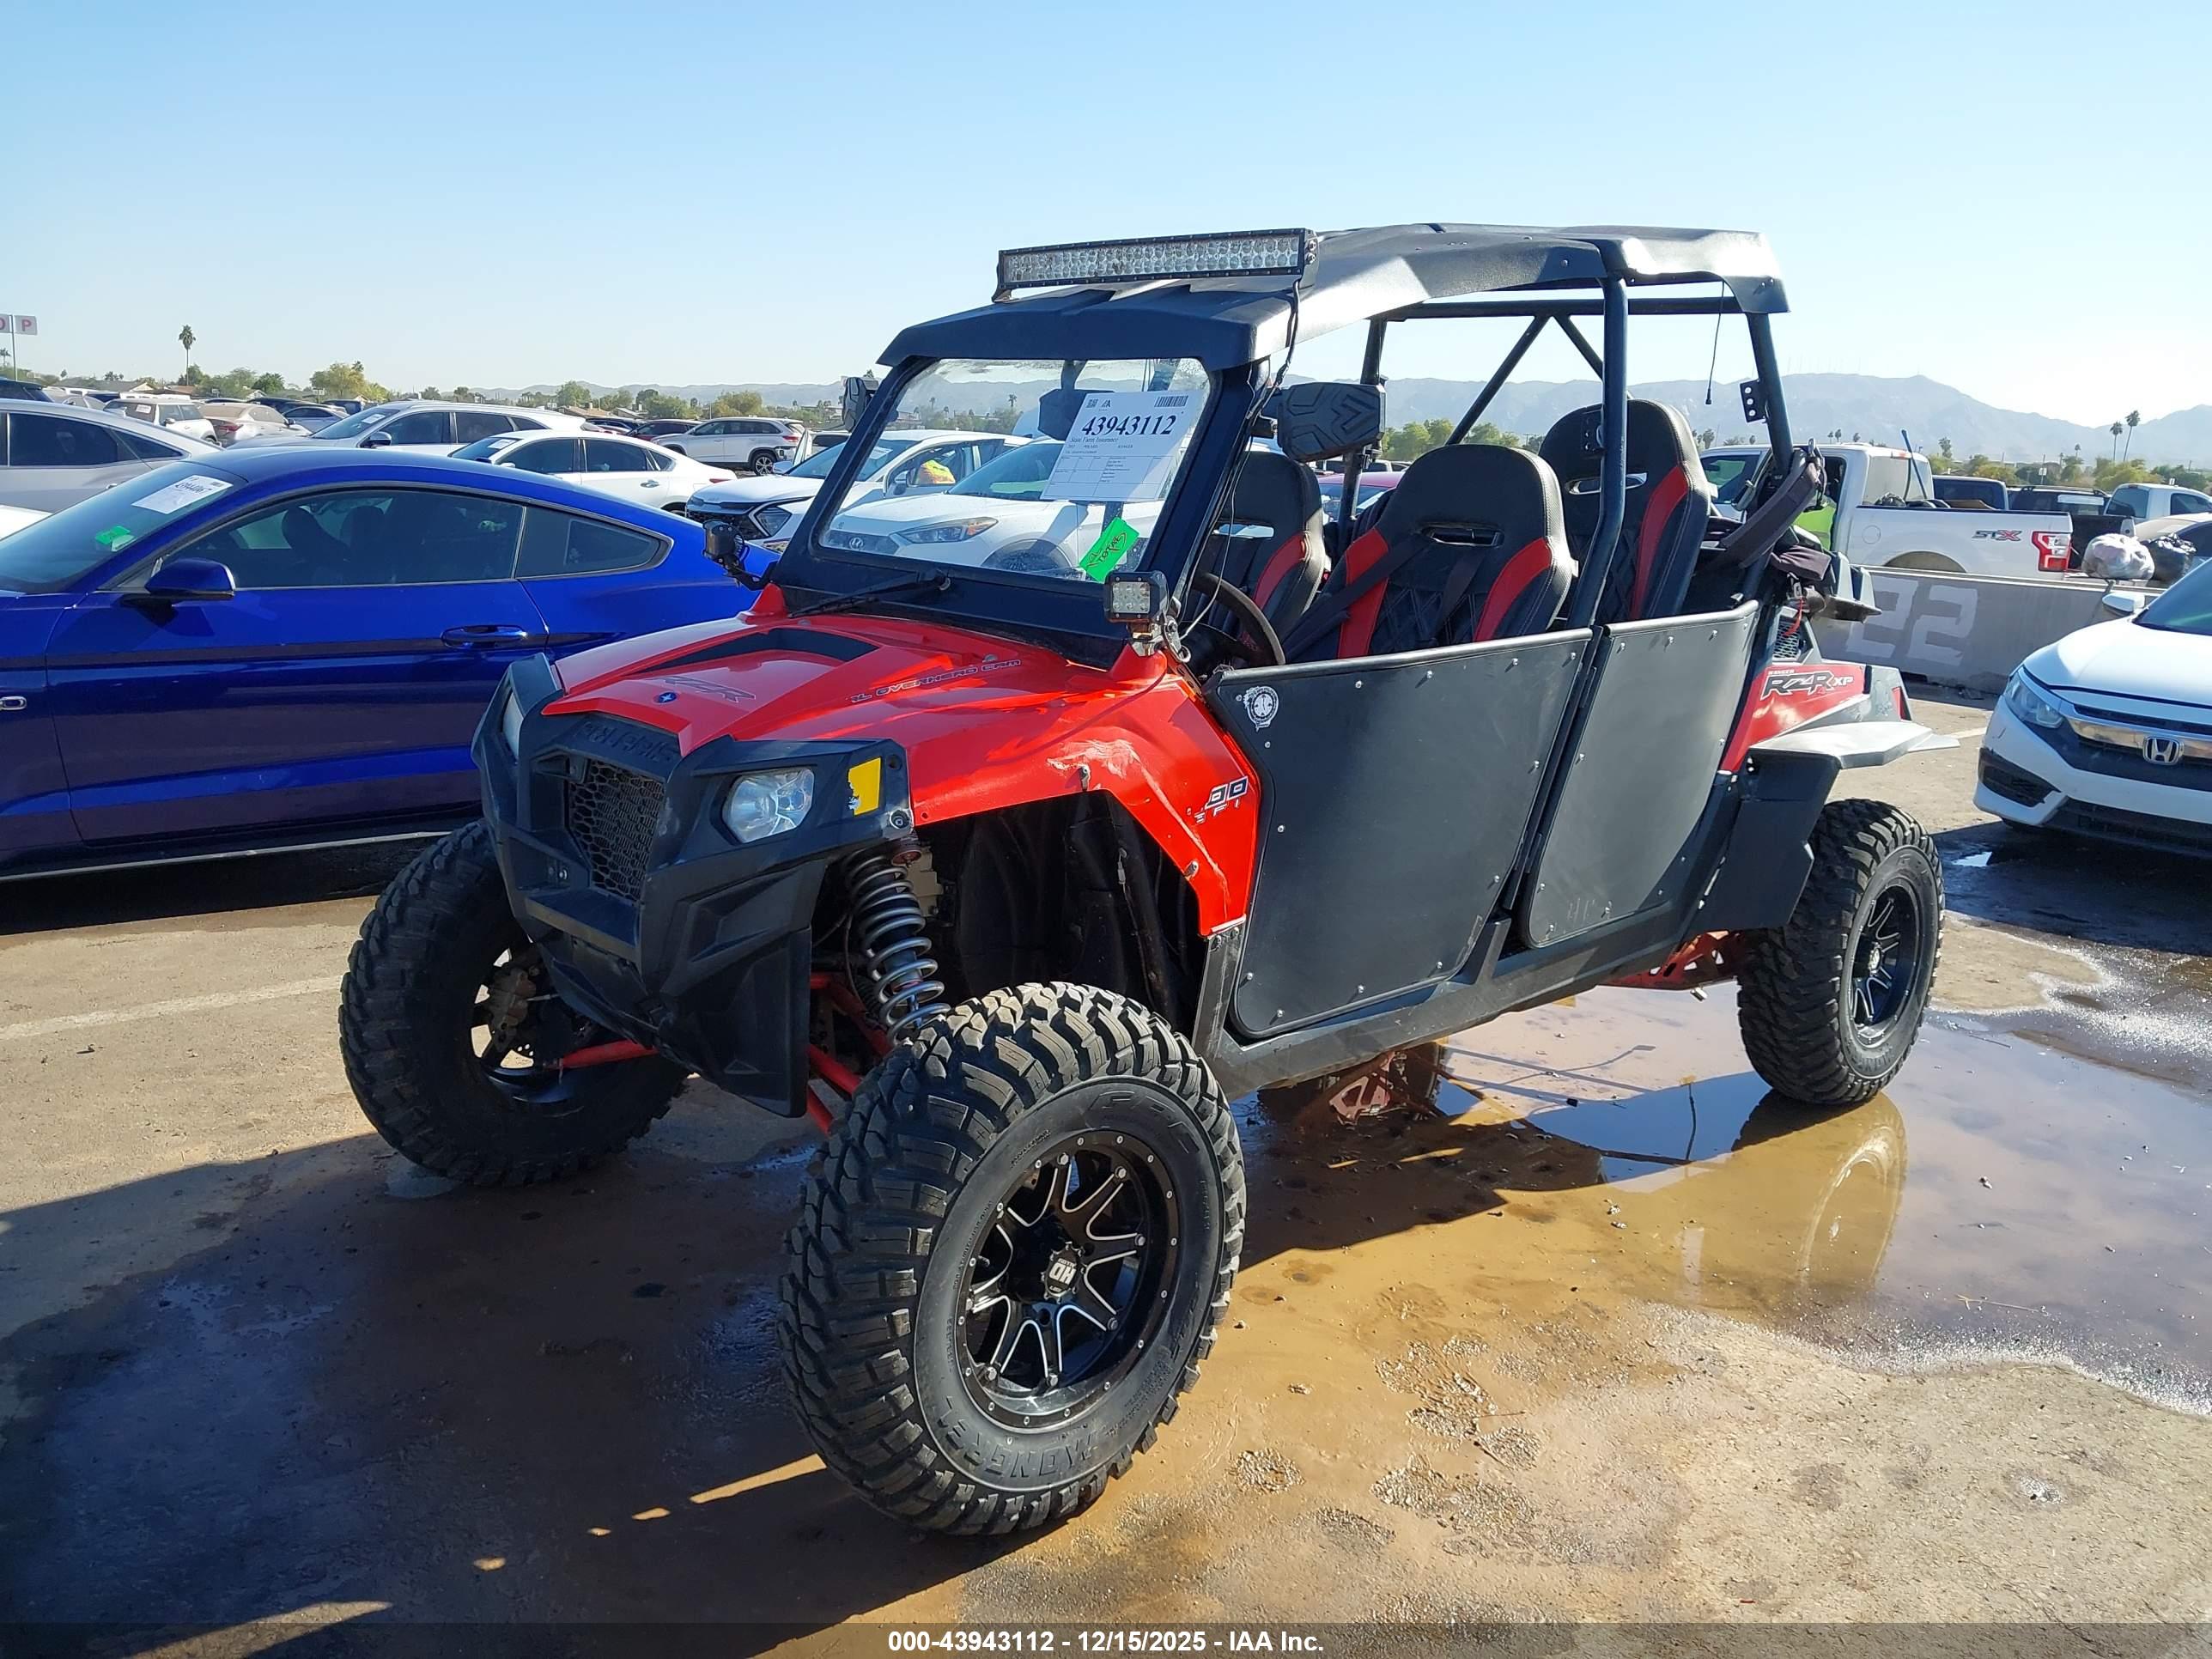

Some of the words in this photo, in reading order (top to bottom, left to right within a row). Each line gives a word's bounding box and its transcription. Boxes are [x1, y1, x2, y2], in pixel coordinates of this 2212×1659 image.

[1082, 415, 1177, 436] 43943112
[1972, 529, 2023, 542] STX
[1846, 574, 1978, 666] 22
[1832, 676, 1855, 687] XP
